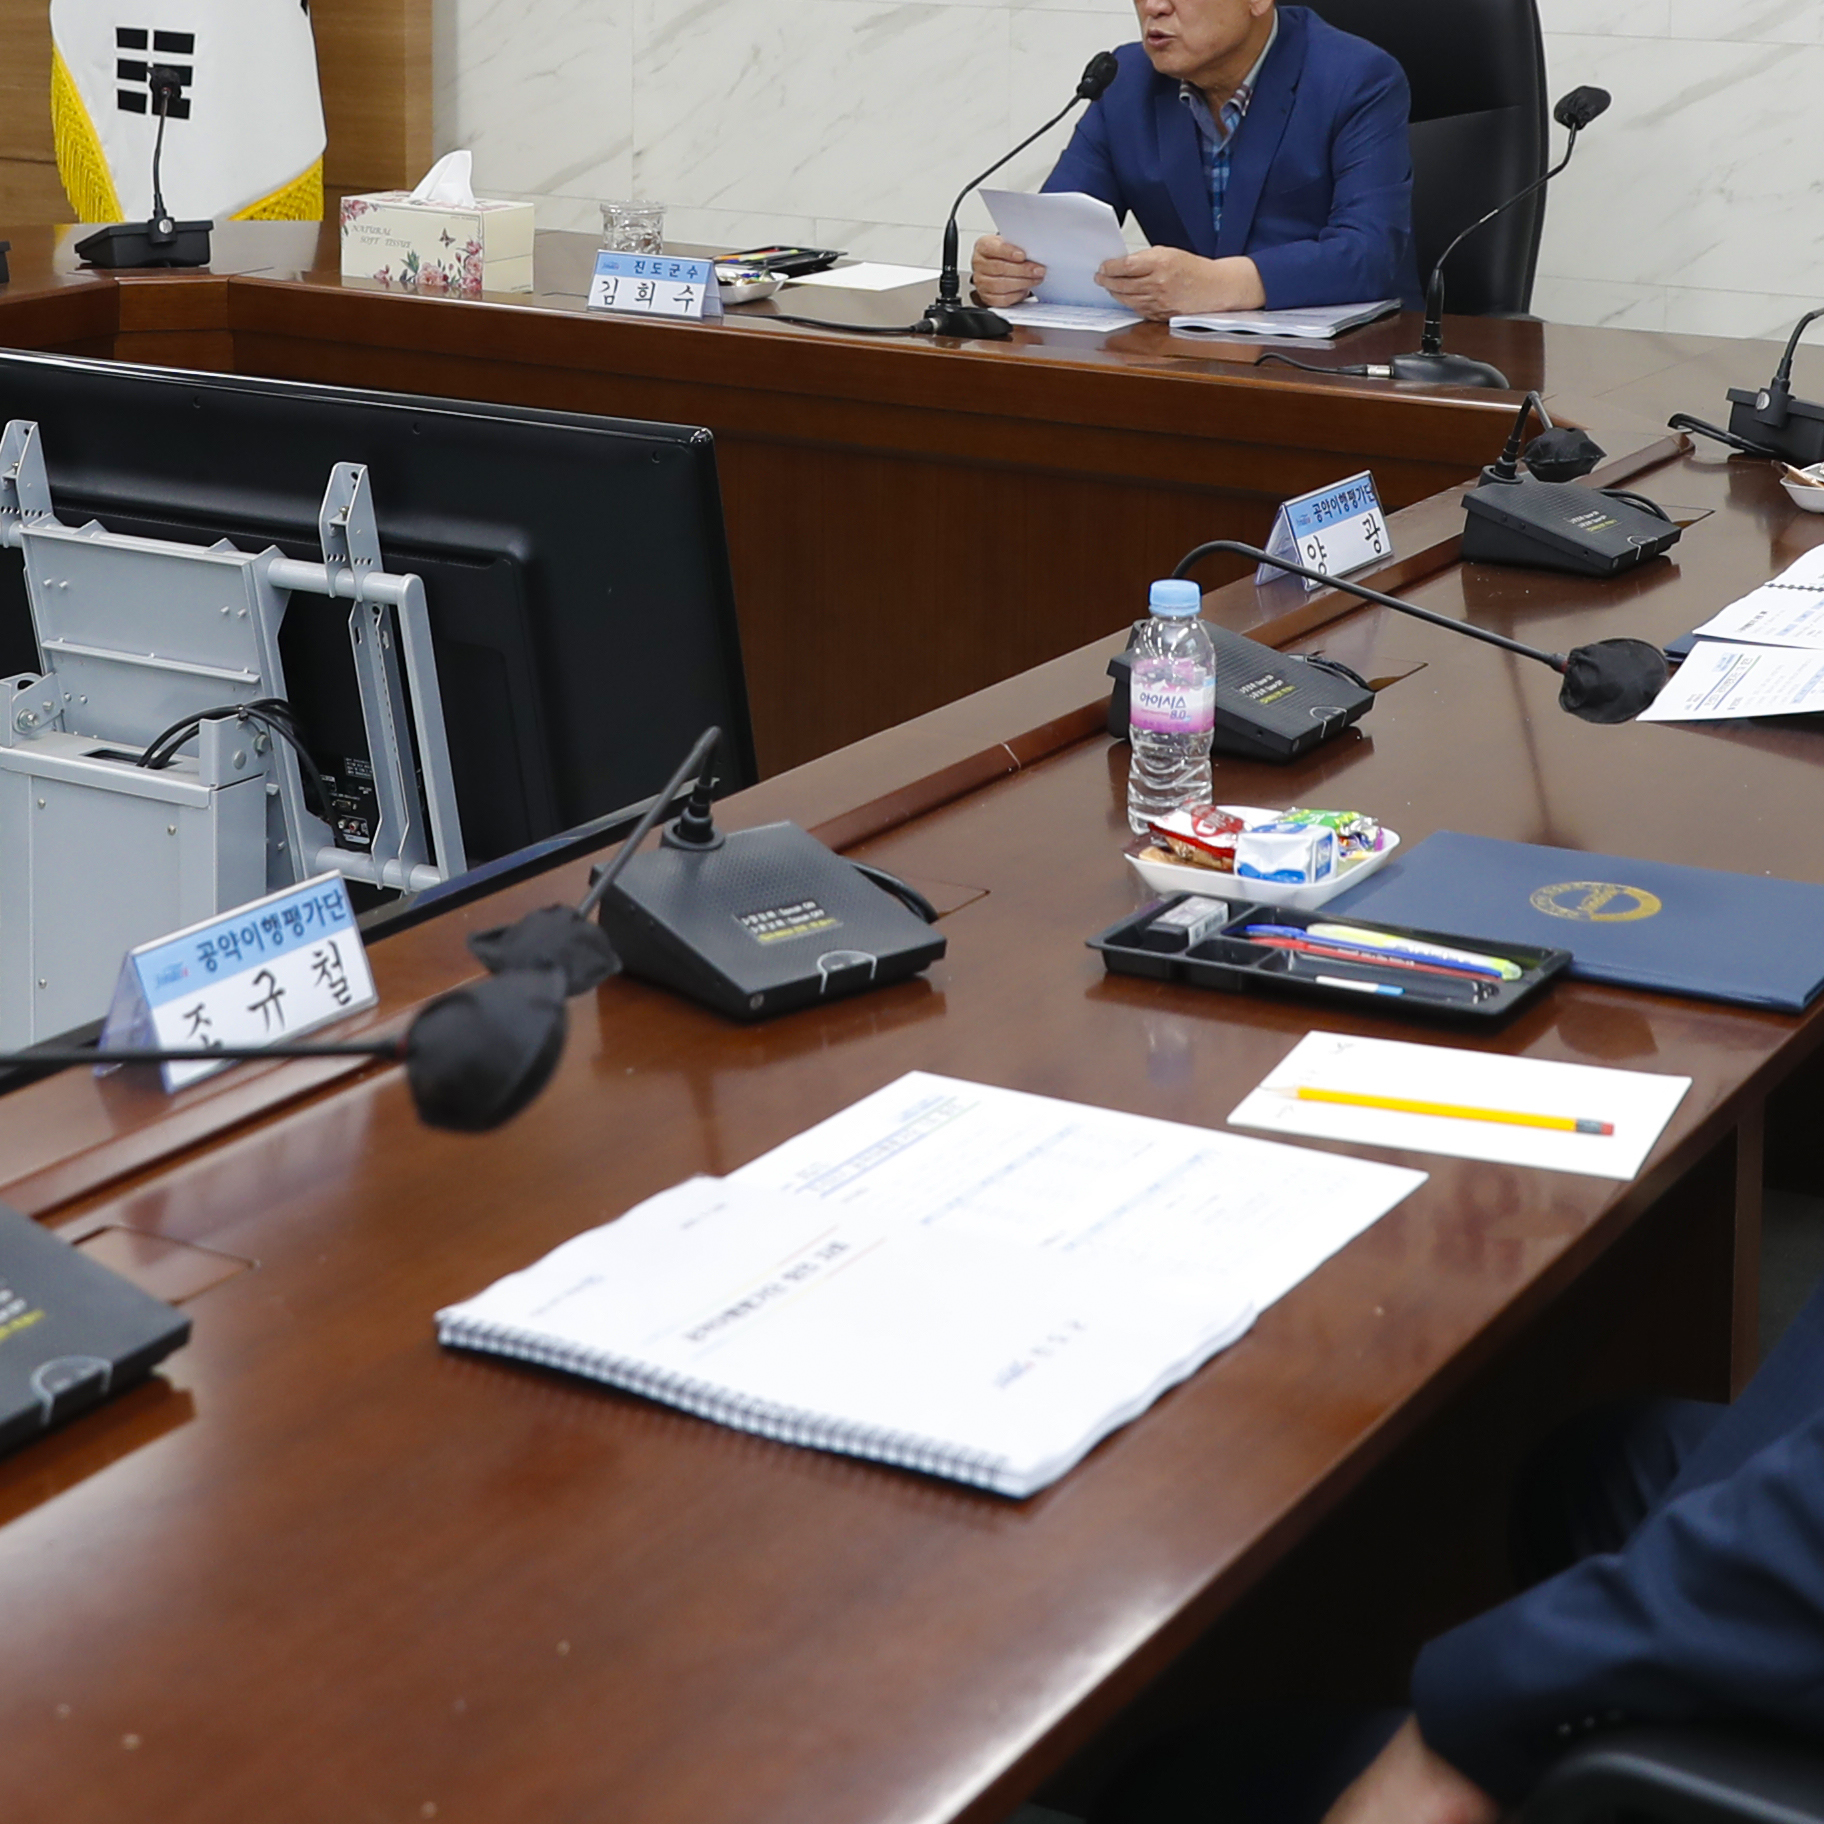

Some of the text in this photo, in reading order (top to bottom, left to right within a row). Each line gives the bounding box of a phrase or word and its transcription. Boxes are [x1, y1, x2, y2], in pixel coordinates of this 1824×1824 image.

[633, 259, 699, 279] 진도군수
[598, 276, 695, 314] 김희수
[1311, 481, 1377, 524] 공약이행평가단
[1139, 691, 1187, 710] 아이시스
[195, 888, 347, 973] 공약이행평가단
